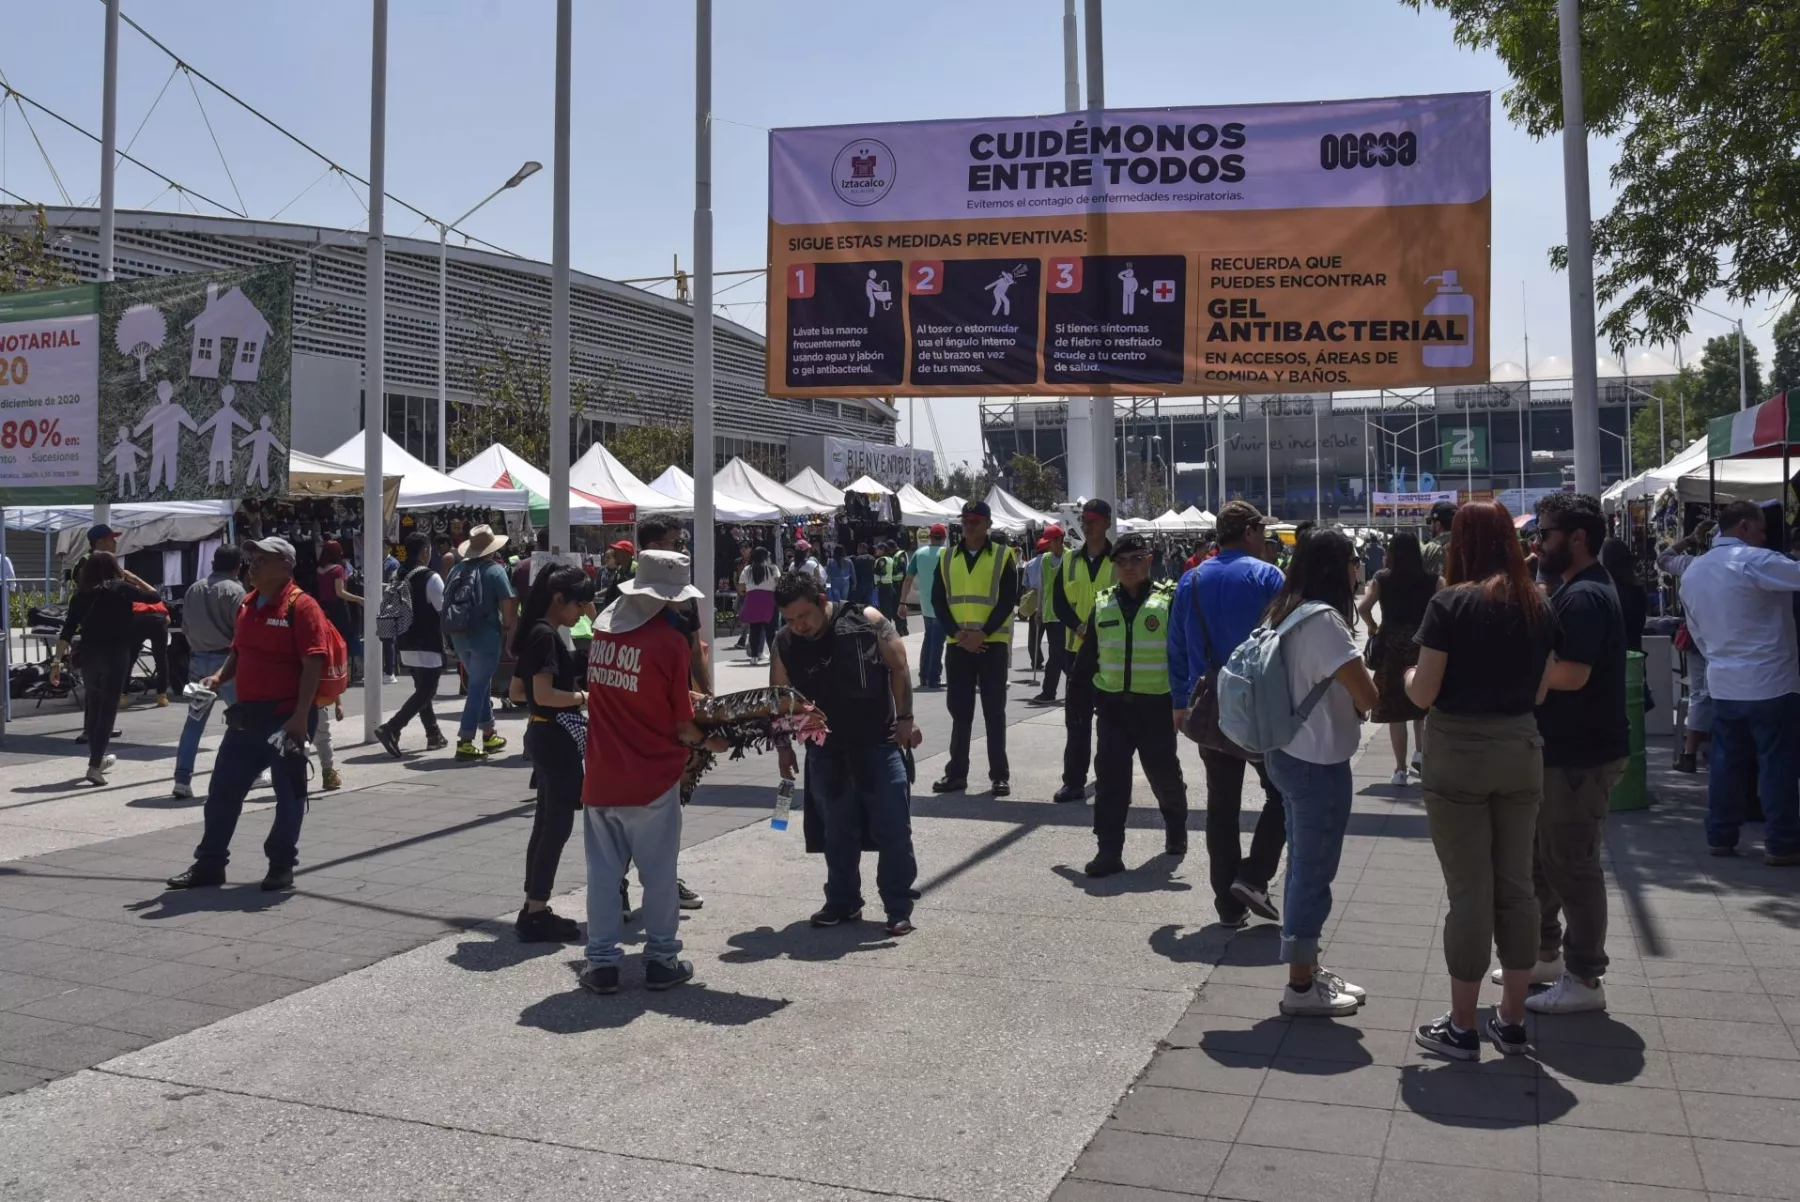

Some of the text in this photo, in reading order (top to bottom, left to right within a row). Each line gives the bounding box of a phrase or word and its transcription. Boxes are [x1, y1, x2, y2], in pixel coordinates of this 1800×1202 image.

[970, 120, 1246, 161] CUIDÉMONOS
[968, 154, 1246, 192] ENTRE TODOS
[841, 178, 885, 189] Iztacalco
[967, 190, 1244, 209] Evitemos el contagio de enfermedades respiratorias.
[789, 229, 1088, 251] SIGUE ESTAS MEDIDAS PREVENTIVAS:
[1211, 256, 1342, 271] RECUERDA QUE
[795, 269, 804, 294] 1
[916, 266, 935, 290] 2
[1055, 263, 1074, 289] 3
[1211, 273, 1387, 289] PUEDES ENCONTRAR
[1207, 298, 1266, 319] GEL
[793, 326, 868, 336] Lávate las manos
[917, 324, 1019, 334] Al toser o estornudar
[1055, 323, 1149, 333] Si tienes síntomas
[1206, 319, 1464, 342] ANTIBACTERIAL
[793, 339, 861, 349] frecuentemente
[917, 337, 1016, 348] usa el ángulo interno
[1055, 337, 1162, 346] de fiebre o resfriado
[793, 351, 884, 362] usando agua y jabón
[918, 350, 931, 360] de
[932, 351, 942, 359] tu
[943, 350, 971, 359] brazo
[987, 351, 1005, 359] vez
[1053, 350, 1146, 360] acude a tu centro
[1205, 349, 1398, 366] EN ACCESOS, ÁREAS DE
[792, 364, 873, 376] o gel antibacterial.
[918, 364, 984, 373] de tus manos.
[1054, 362, 1100, 372] de salud.
[1205, 368, 1351, 383] COMIDA Y BAÑOS.
[1, 394, 80, 409] diciembre de 2020
[1, 418, 80, 449] 80% en:
[1230, 434, 1358, 451] Vivir es increíble
[1452, 429, 1475, 455] 2
[616, 644, 642, 674] SOL
